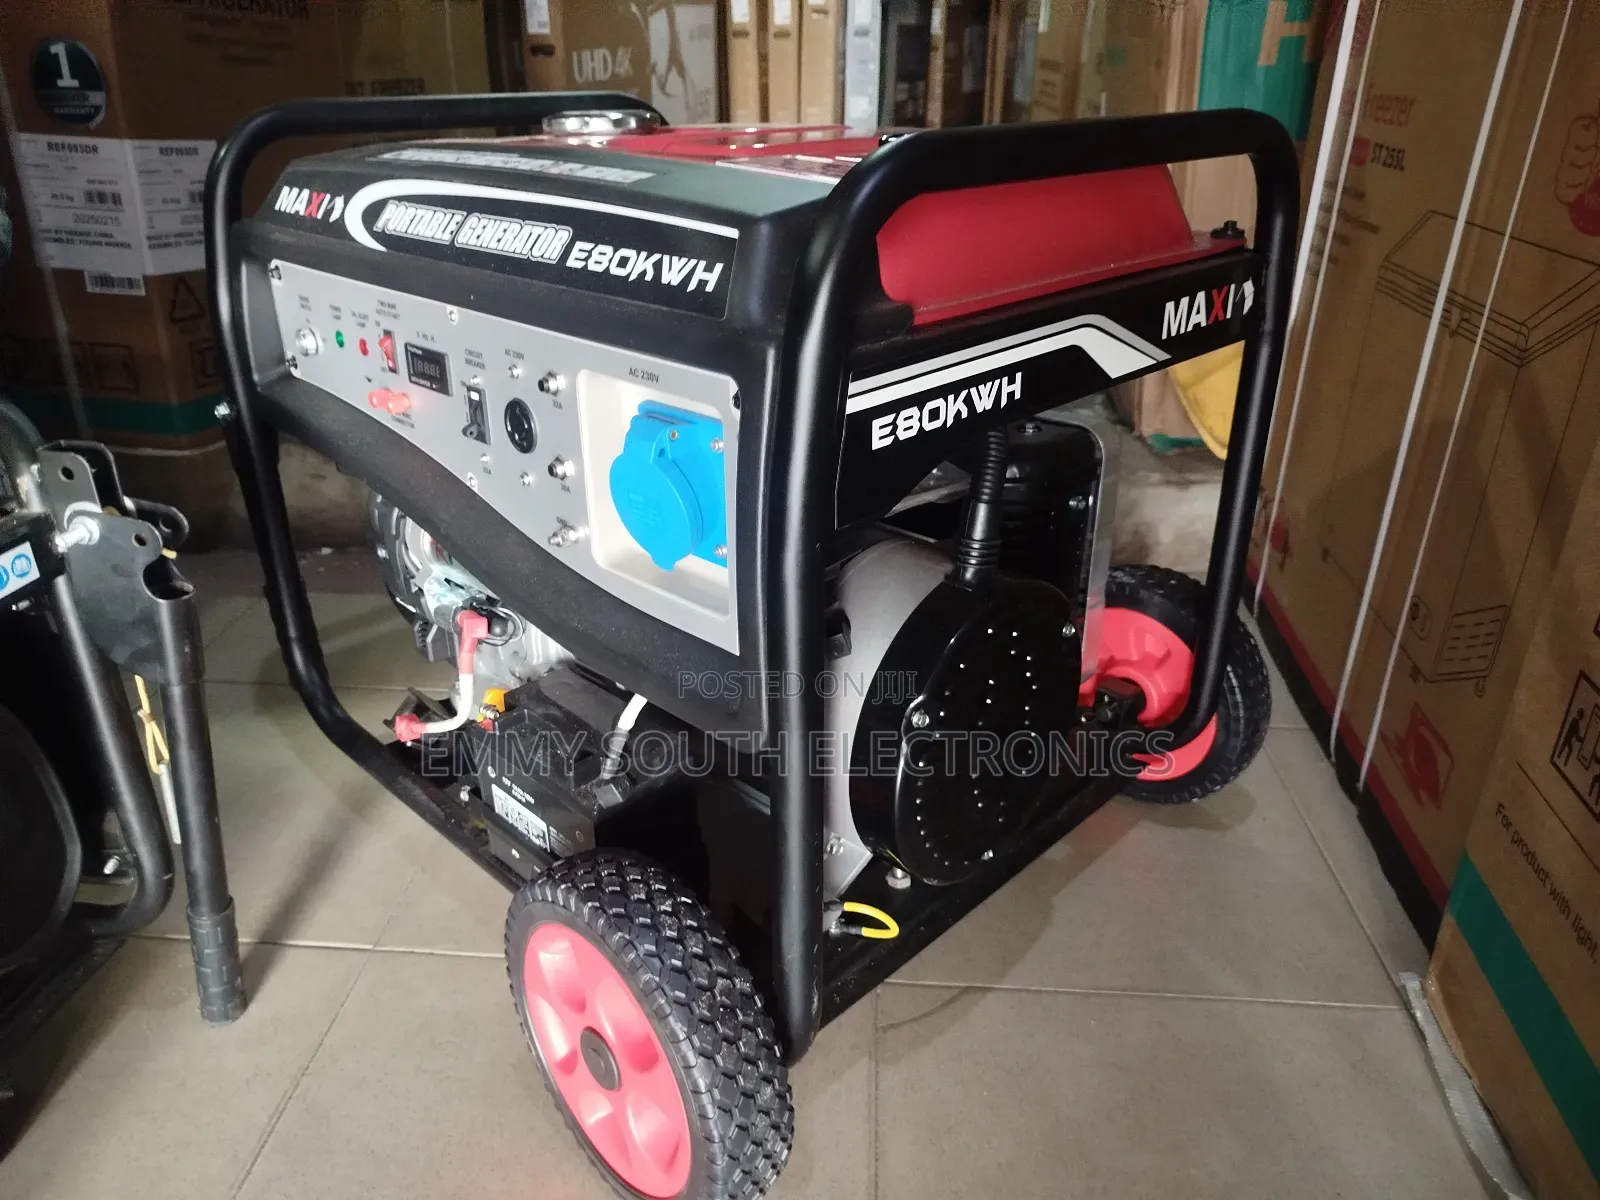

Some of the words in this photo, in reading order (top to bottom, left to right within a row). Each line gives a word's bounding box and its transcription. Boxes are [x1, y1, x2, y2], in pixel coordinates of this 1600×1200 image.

[49, 42, 80, 88] 1
[572, 48, 614, 84] UHD
[275, 186, 329, 219] MAXI
[373, 199, 466, 245] PORTABLE
[454, 212, 573, 263] GENERATOR
[566, 240, 725, 294] E80KWH
[1162, 284, 1234, 340] MAXI
[628, 367, 640, 379] AC
[640, 370, 660, 383] 230V
[871, 371, 1023, 451] E80KWH
[1495, 801, 1511, 831] For
[1510, 828, 1551, 889] product
[1549, 882, 1574, 921] with
